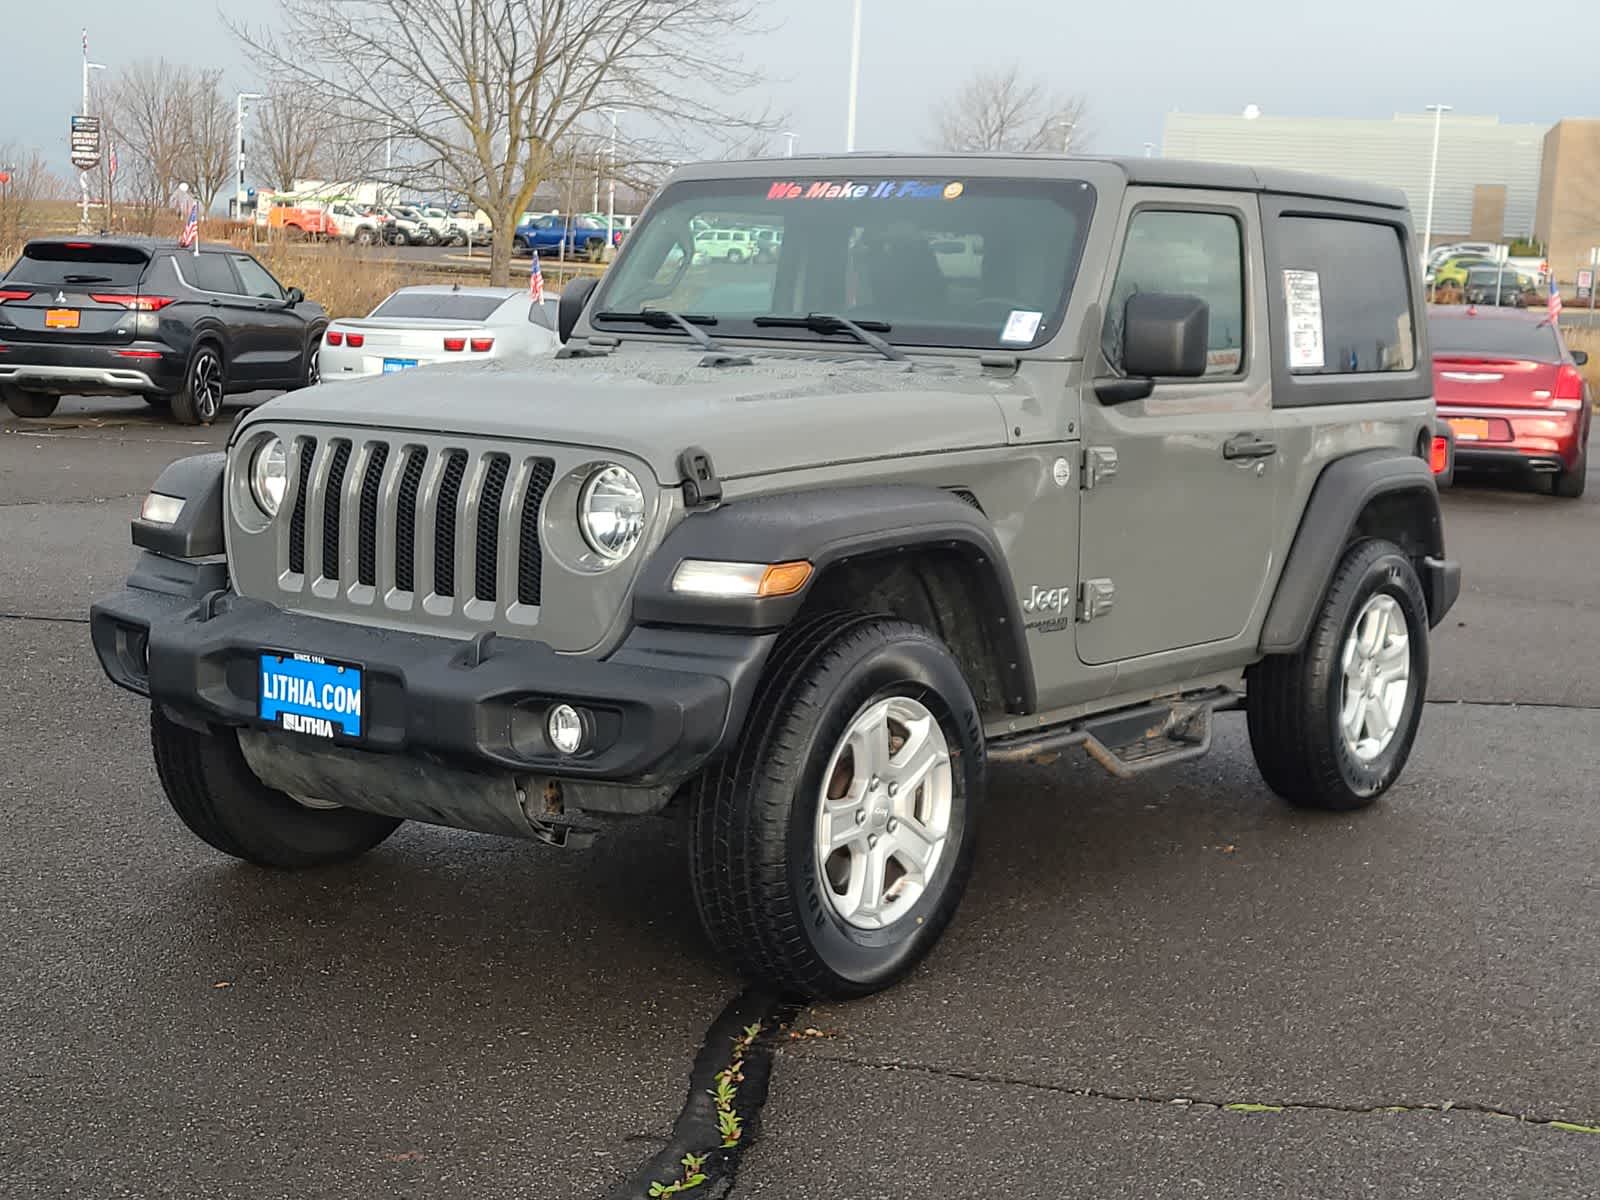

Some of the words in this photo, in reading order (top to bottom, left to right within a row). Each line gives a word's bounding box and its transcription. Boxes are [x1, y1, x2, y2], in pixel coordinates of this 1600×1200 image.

[767, 181, 802, 198] We
[805, 181, 868, 198] Make
[871, 181, 897, 198] It
[1023, 585, 1070, 614] Jeep
[263, 672, 361, 716] LITHIA.COM
[294, 714, 334, 738] LITHIA
